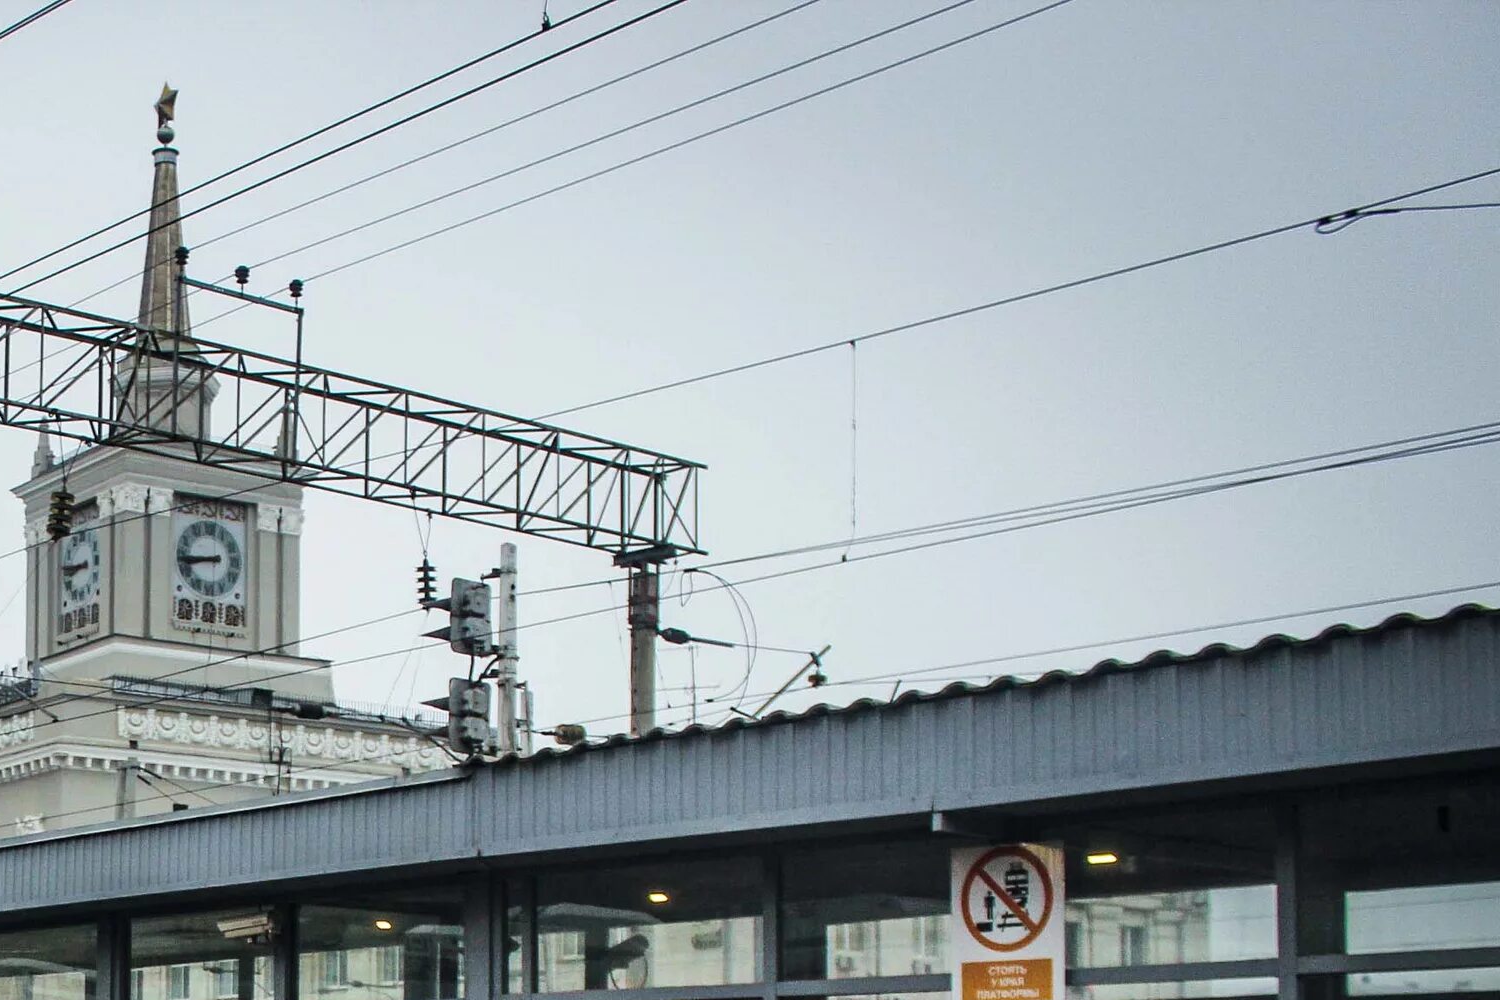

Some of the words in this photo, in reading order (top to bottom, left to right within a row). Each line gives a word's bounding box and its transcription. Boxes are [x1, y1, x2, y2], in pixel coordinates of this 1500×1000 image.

[988, 965, 1027, 976] СТОЯТЬ
[991, 978, 997, 988] У
[1000, 977, 1024, 987] КРАЯ
[977, 988, 1039, 1000] ПЛАТФОРМЫ
